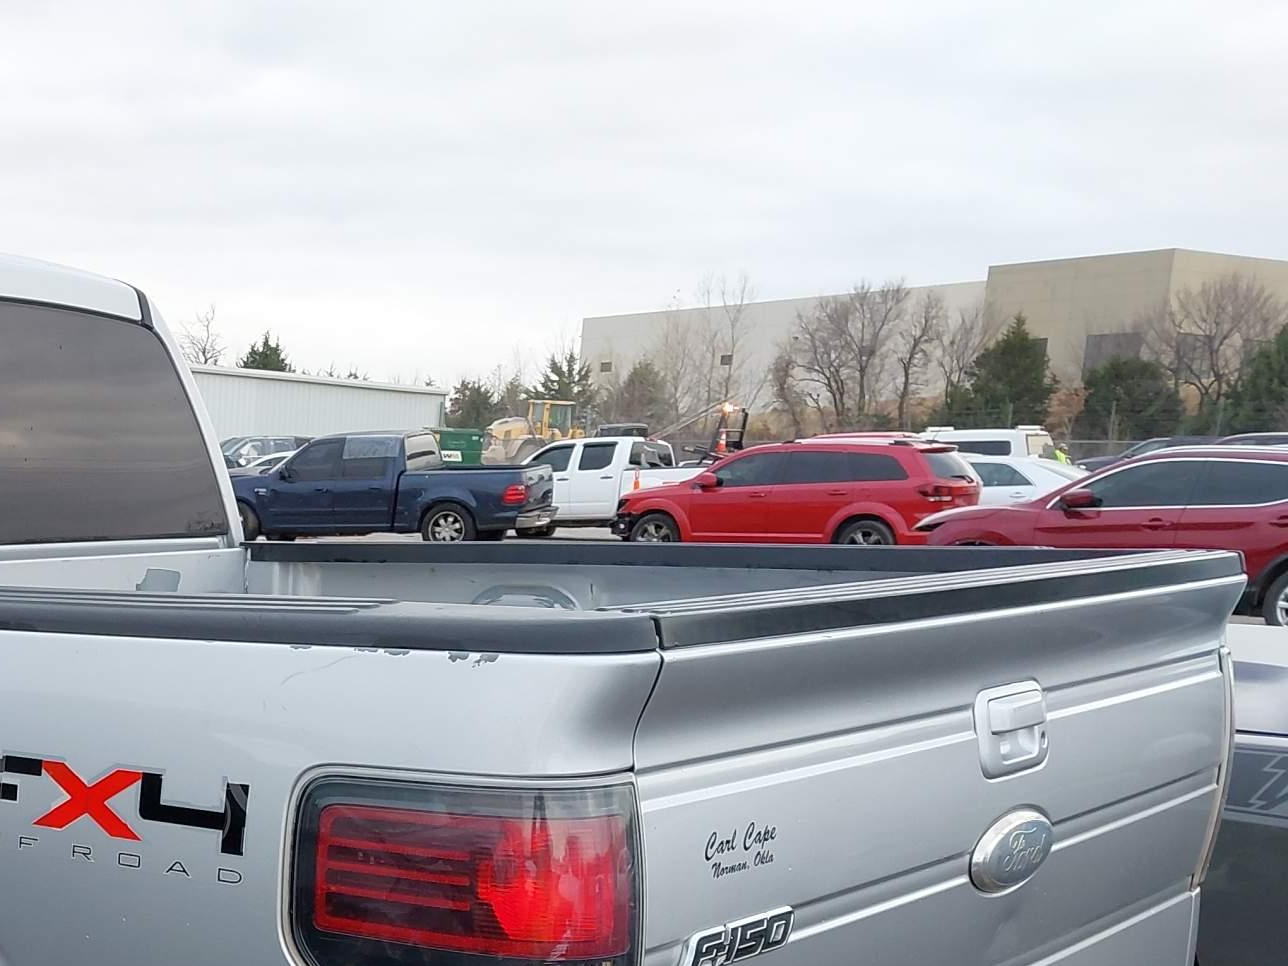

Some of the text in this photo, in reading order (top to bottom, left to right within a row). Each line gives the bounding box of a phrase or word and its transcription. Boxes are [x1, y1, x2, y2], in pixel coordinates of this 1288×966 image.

[704, 821, 777, 862] Carl Cape
[1003, 826, 1046, 872] Ford
